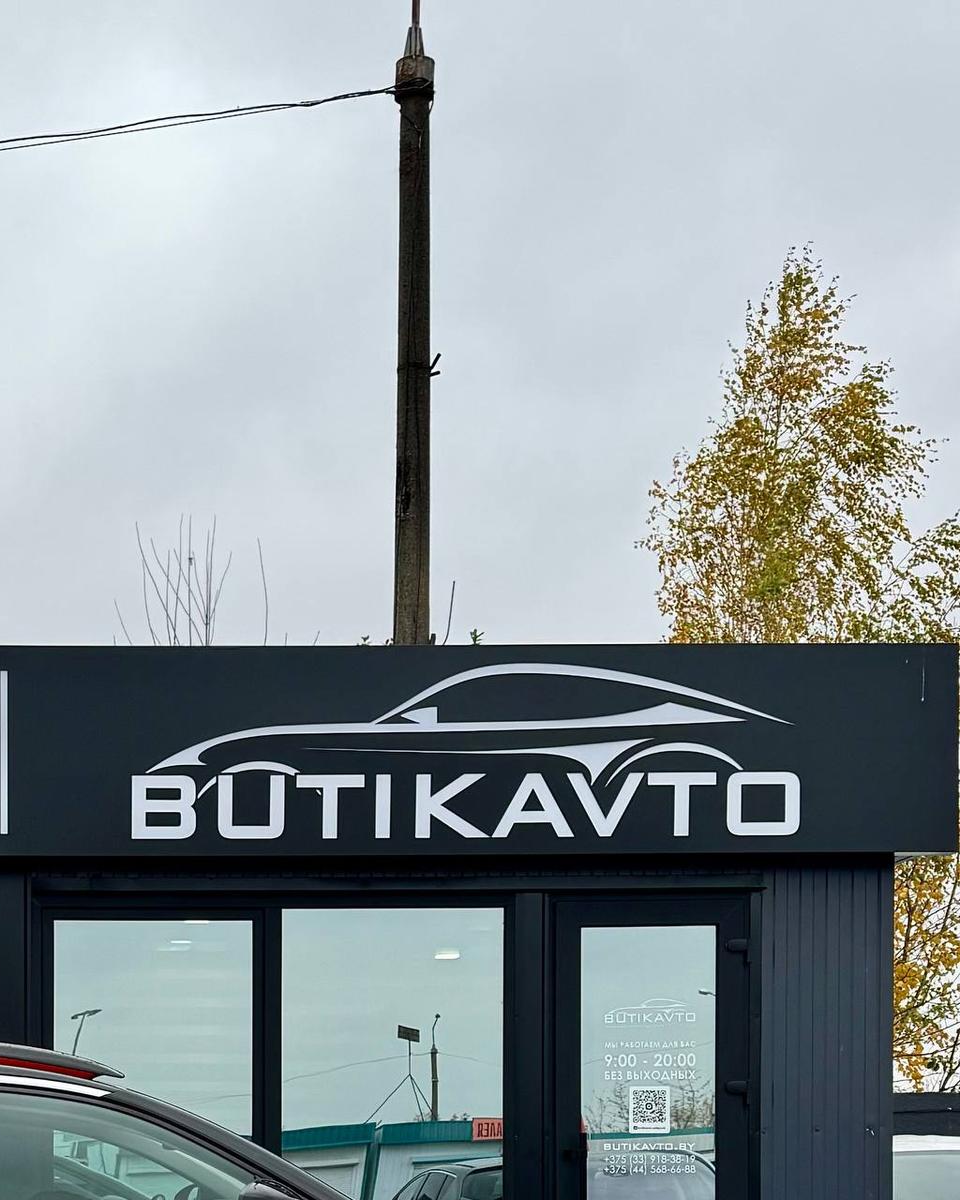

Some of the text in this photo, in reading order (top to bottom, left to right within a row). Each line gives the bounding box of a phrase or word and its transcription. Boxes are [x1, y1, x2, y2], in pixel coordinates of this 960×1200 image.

[131, 771, 801, 840] BUTIKAVTO
[604, 1012, 696, 1023] BUTIKAVTO
[604, 1054, 637, 1068] 9:00
[653, 1053, 696, 1067] 20:00
[604, 1070, 696, 1081] БЕЗ ВЫХОДНЫХ
[603, 1142, 696, 1151] BUTIKAVTO.BY
[604, 1154, 696, 1165] +375 (33) 918-38-19
[604, 1164, 696, 1175] +375 (44) 568-66-88
